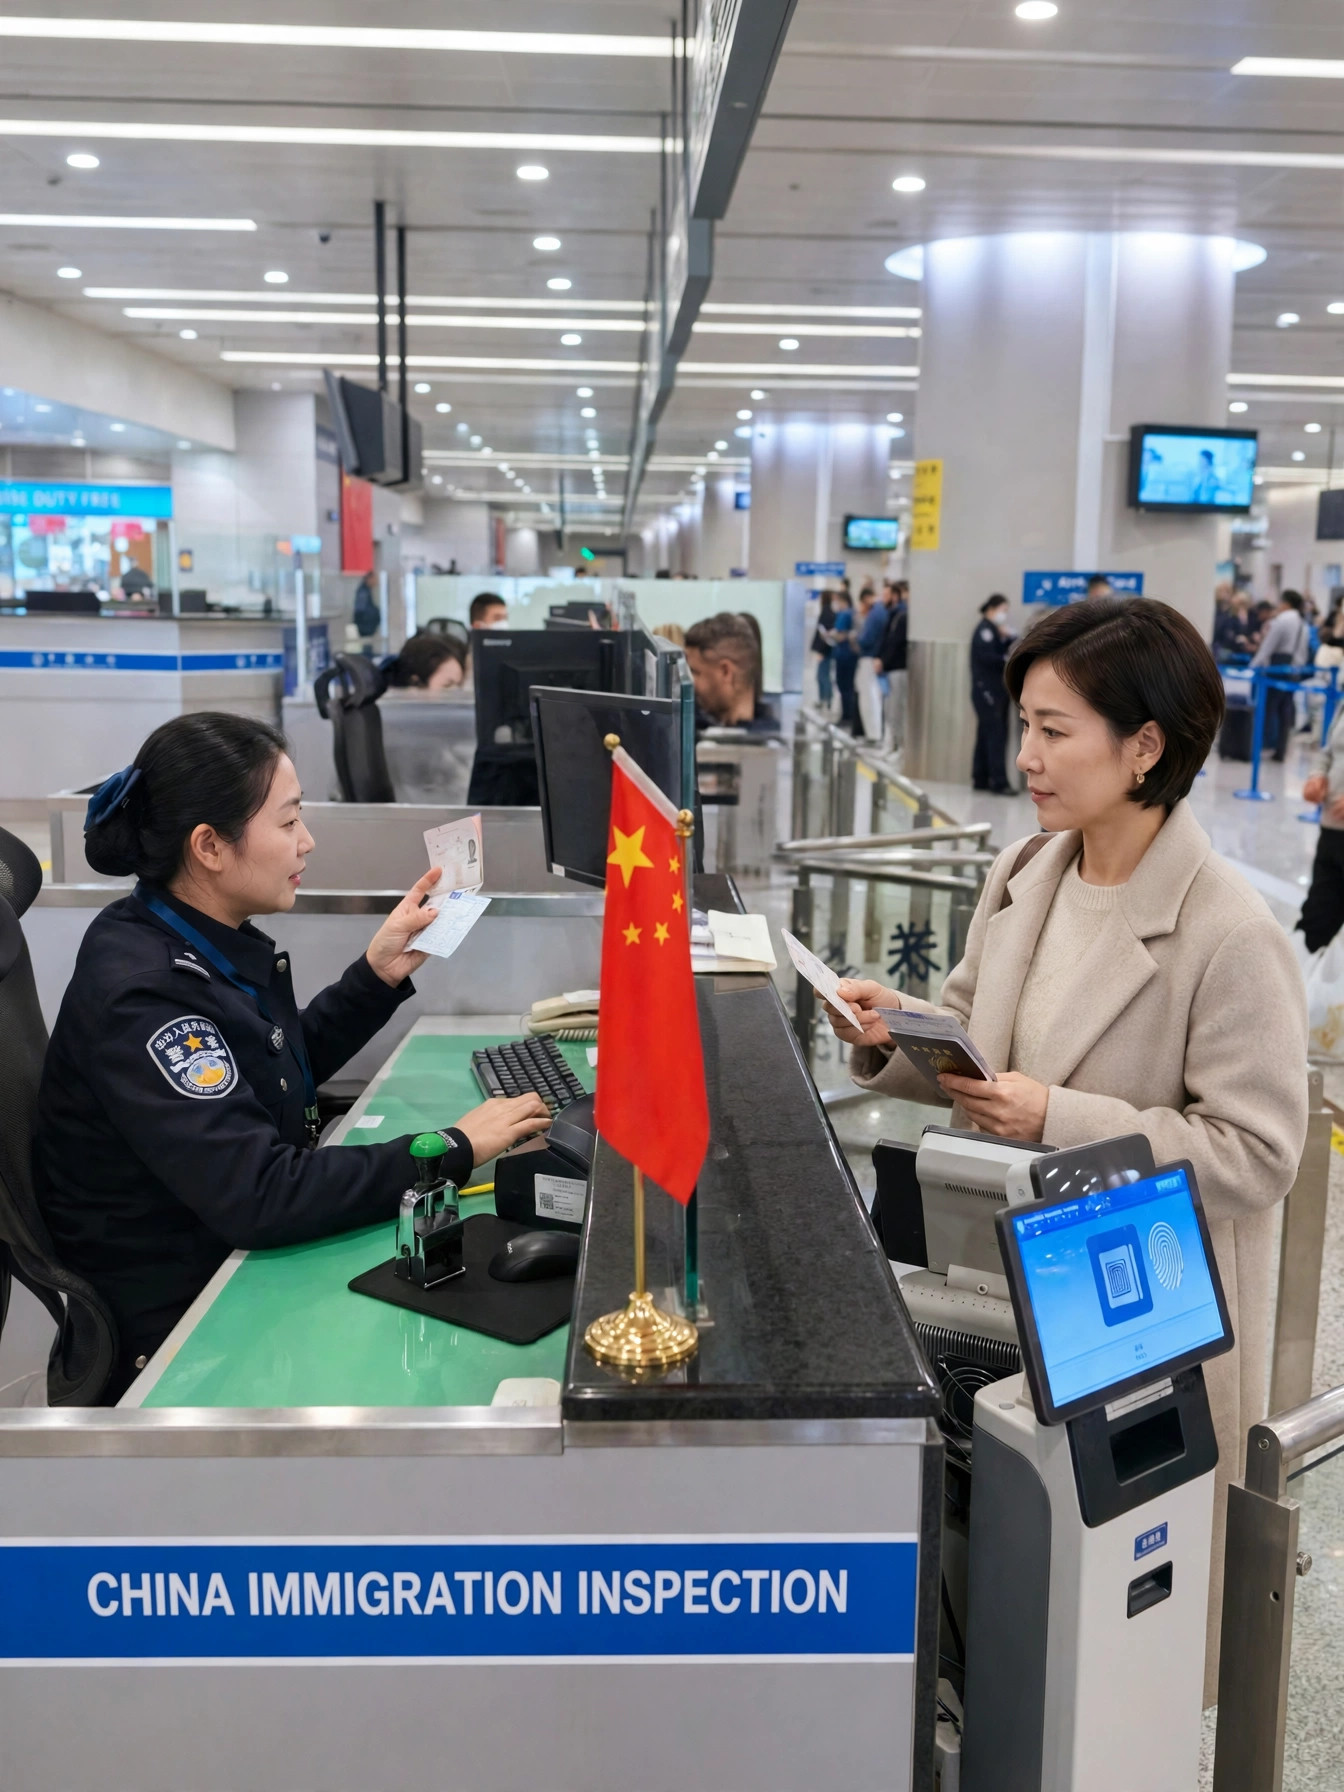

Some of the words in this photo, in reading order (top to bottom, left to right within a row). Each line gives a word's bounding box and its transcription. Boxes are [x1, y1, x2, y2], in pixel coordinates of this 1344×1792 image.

[33, 489, 77, 508] DUTY
[87, 1572, 234, 1616] CHINA
[249, 1571, 561, 1615] IMMIGRATION
[578, 1569, 848, 1613] INSPECTION
